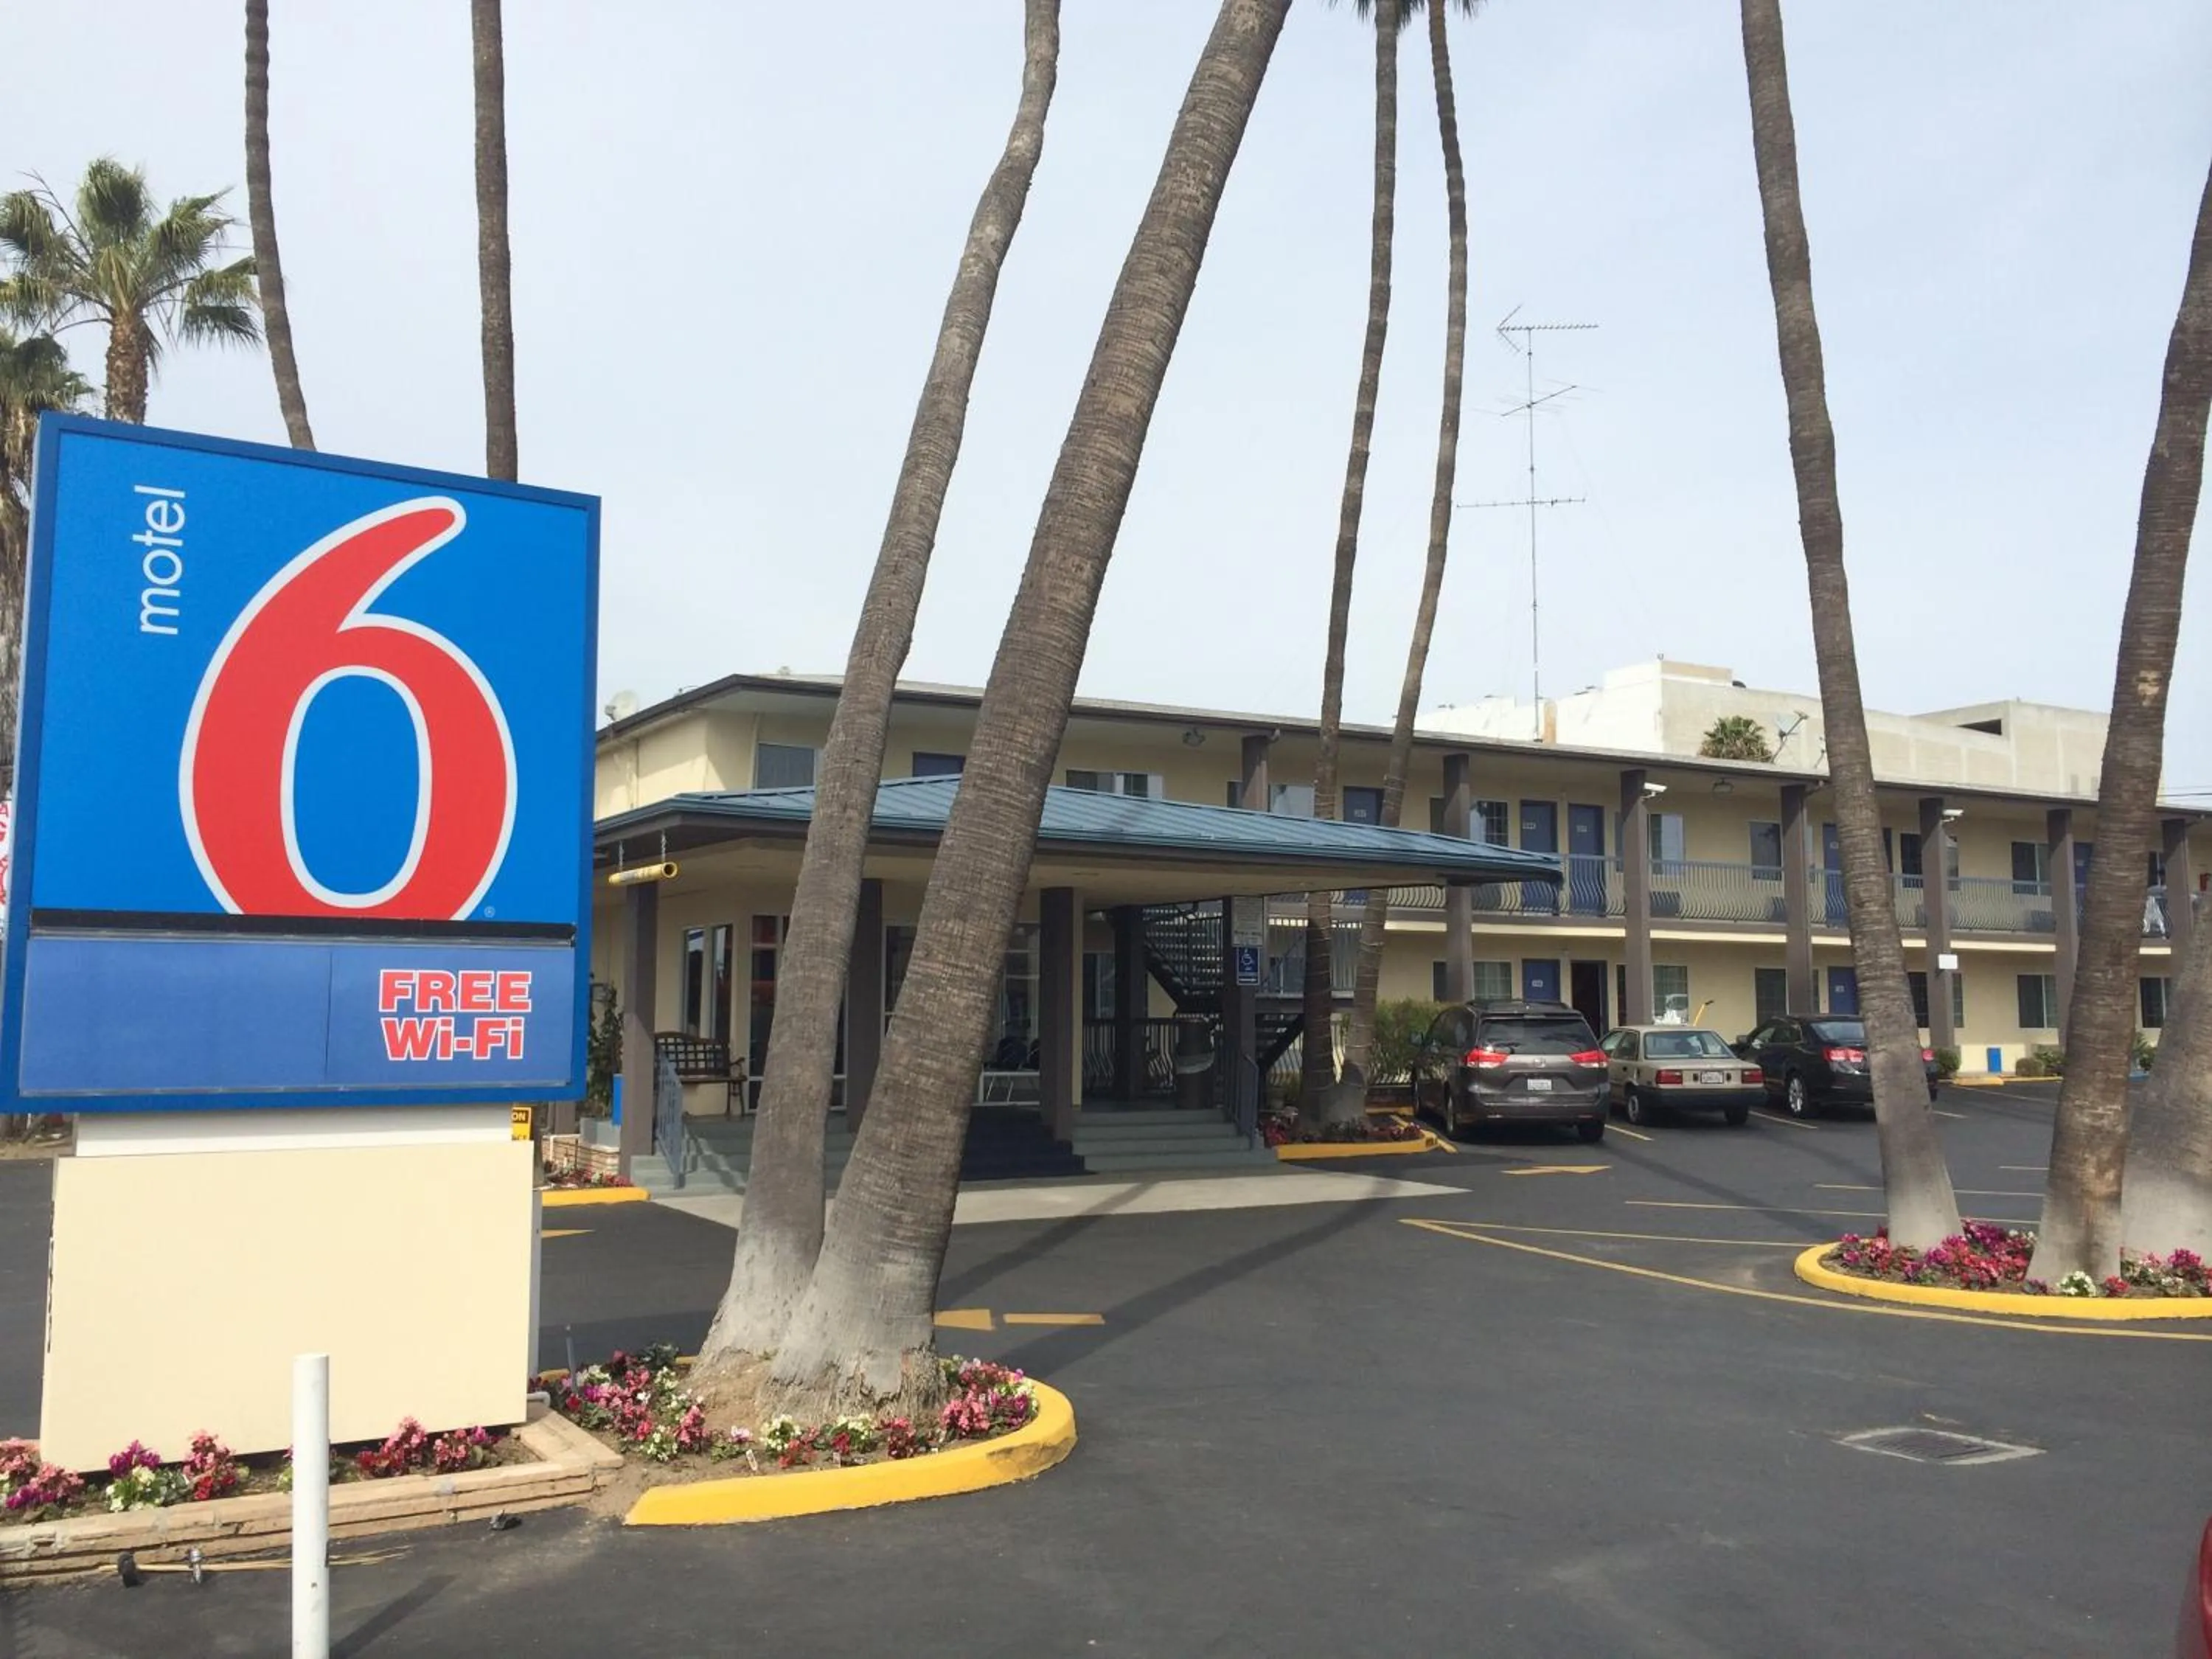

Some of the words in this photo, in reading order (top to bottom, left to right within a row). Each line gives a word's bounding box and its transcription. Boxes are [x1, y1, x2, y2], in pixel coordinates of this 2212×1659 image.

[132, 484, 186, 635] motel
[178, 495, 518, 921] 6
[378, 969, 532, 1012] FREE
[380, 1017, 525, 1061] Wi-Fi
